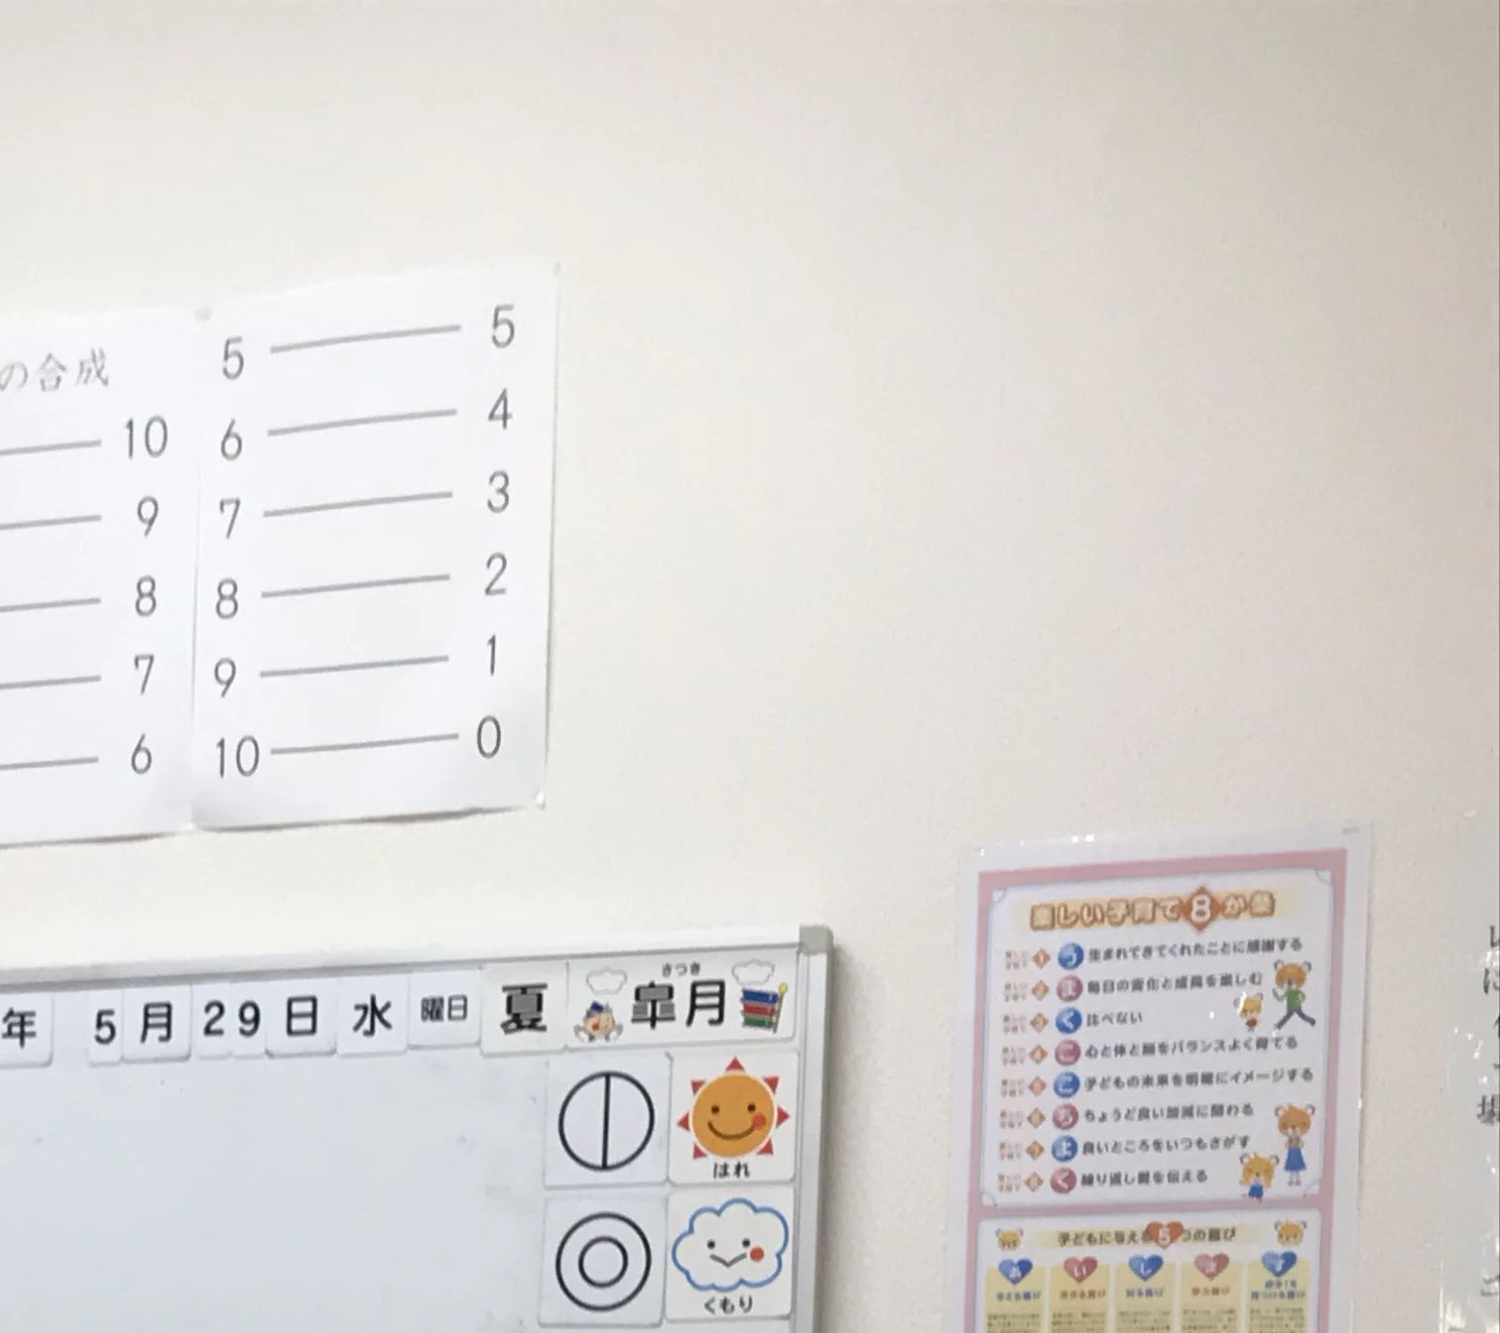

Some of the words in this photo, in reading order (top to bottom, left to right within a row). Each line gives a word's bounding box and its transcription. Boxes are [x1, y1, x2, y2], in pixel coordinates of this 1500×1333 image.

[222, 337, 244, 380] 5
[491, 305, 515, 348] 5
[125, 416, 168, 458] 10
[220, 419, 243, 460] 6
[488, 388, 511, 429] 4
[137, 497, 159, 536] 9
[219, 498, 241, 539] 7
[487, 471, 510, 513] 3
[135, 576, 157, 616] 8
[215, 579, 238, 619] 8
[484, 552, 508, 596] 2
[134, 654, 155, 695] 7
[214, 658, 237, 698] 9
[486, 635, 497, 675] 1
[131, 734, 153, 774] 6
[216, 736, 260, 778] 10
[476, 716, 502, 758] 0
[500, 983, 548, 1035] 夏
[630, 976, 726, 1031] 皐月
[713, 1160, 750, 1179] はれ
[704, 1295, 753, 1314] くもり
